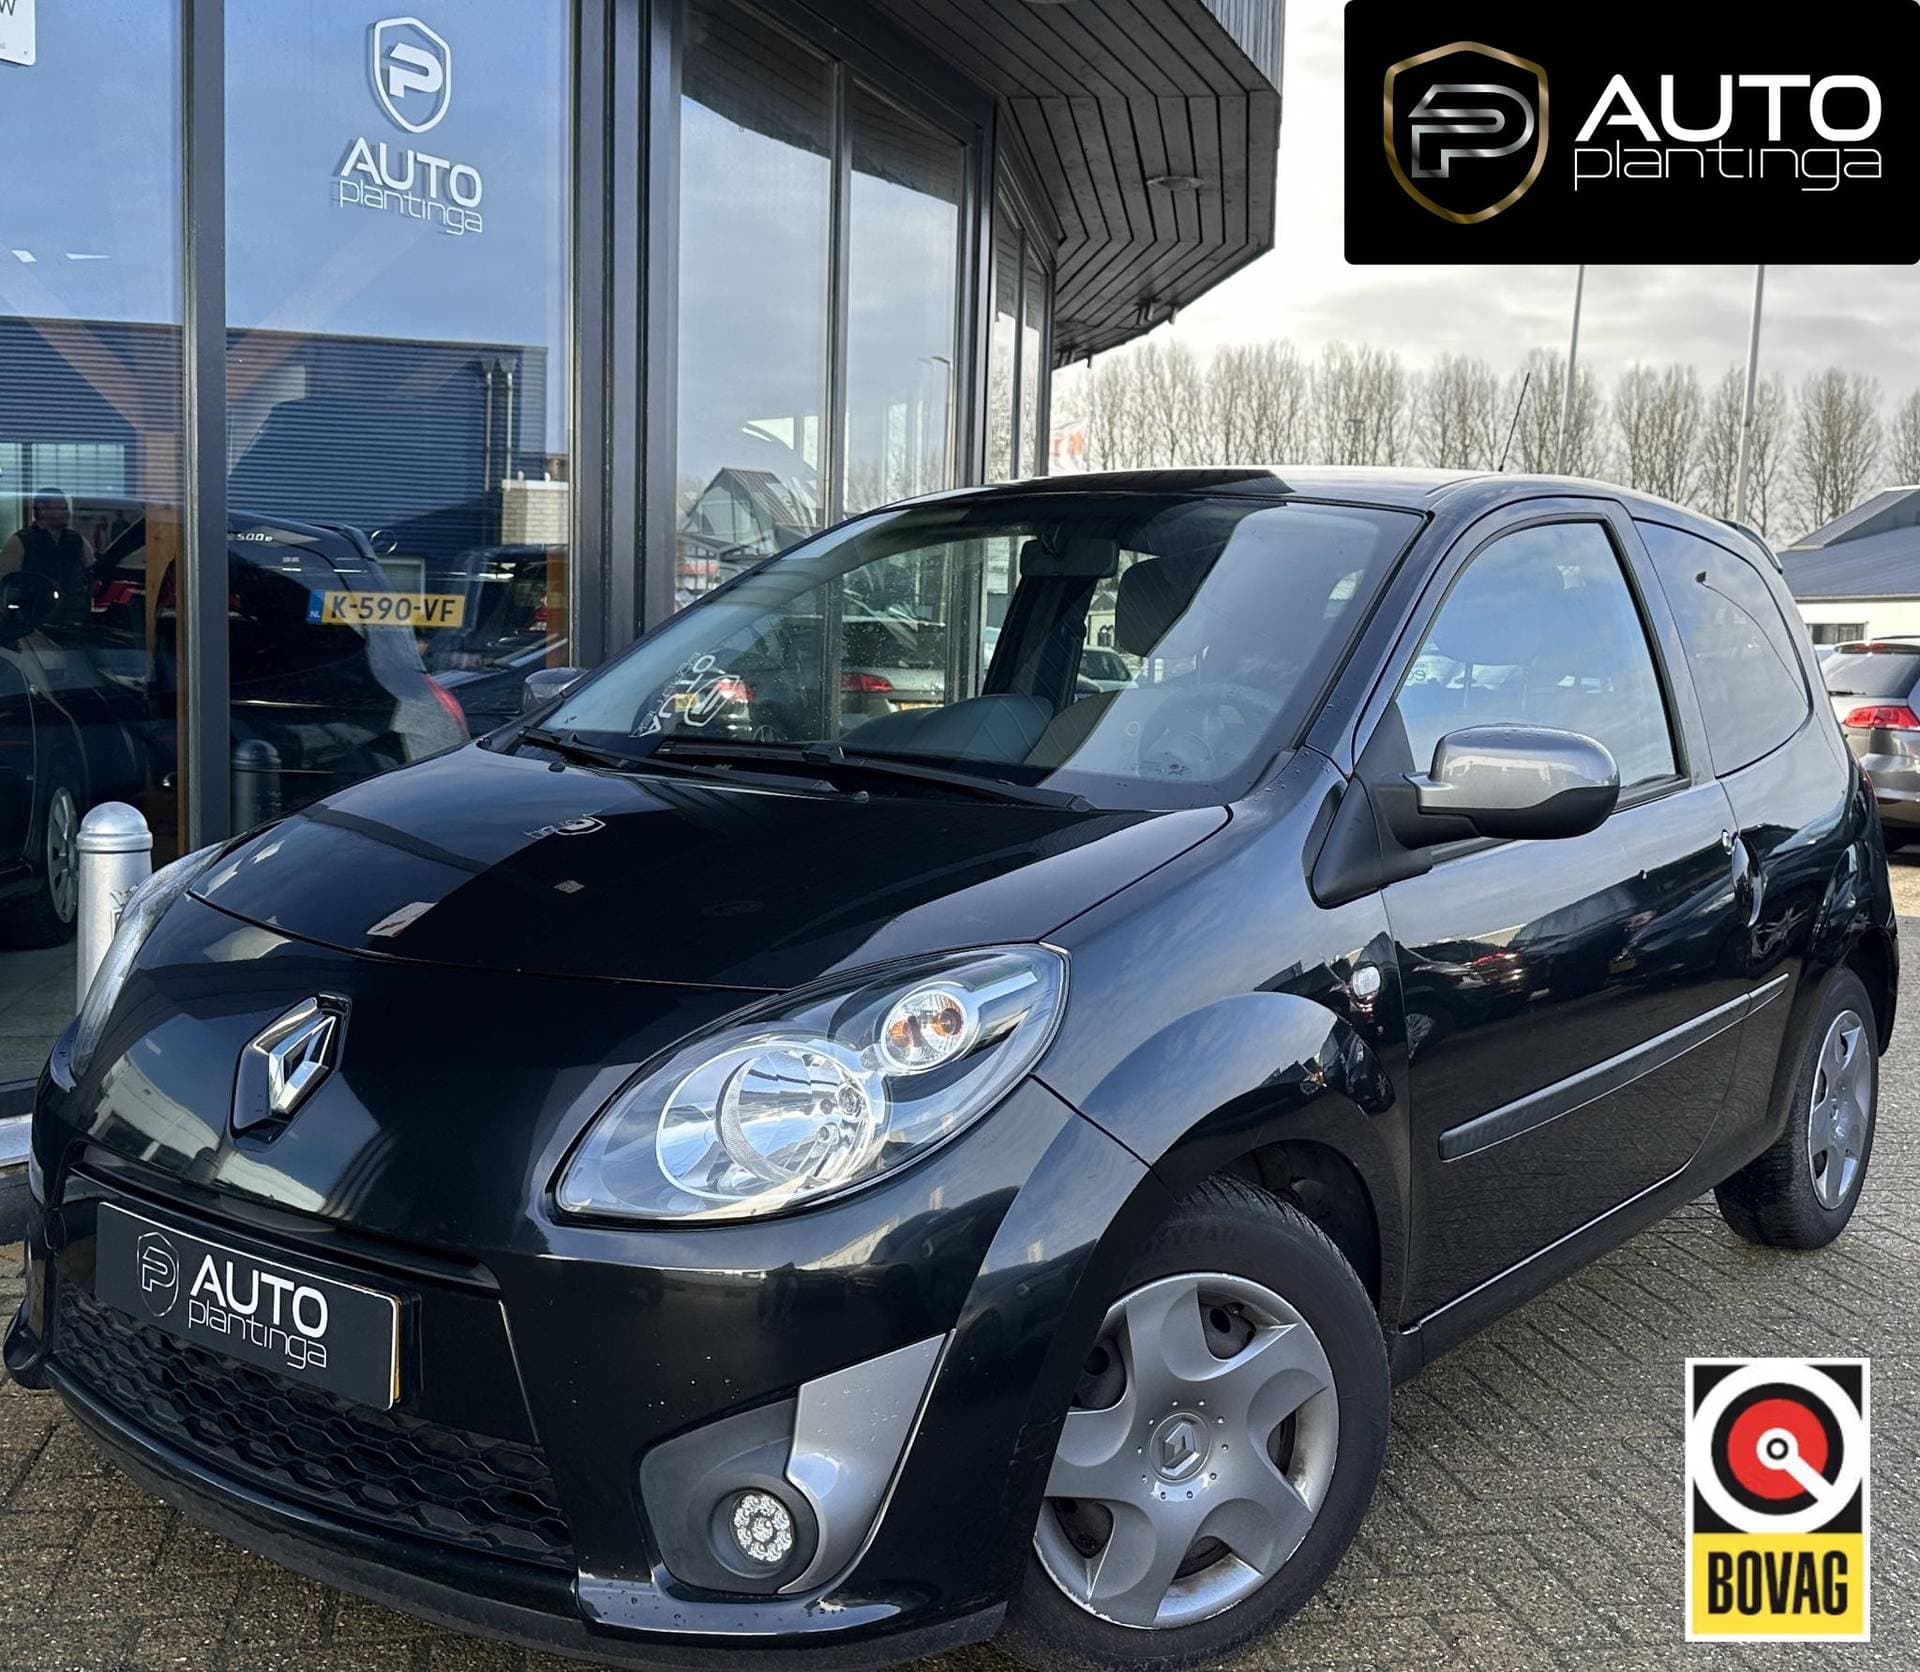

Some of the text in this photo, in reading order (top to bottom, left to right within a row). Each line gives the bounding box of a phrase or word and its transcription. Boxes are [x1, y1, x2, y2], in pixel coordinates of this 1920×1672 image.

[340, 137, 482, 208] AUTO
[340, 179, 483, 235] plantinga
[331, 595, 455, 622] K-590-VF
[190, 1254, 328, 1338] AUTO
[188, 1299, 327, 1369] plantinga
